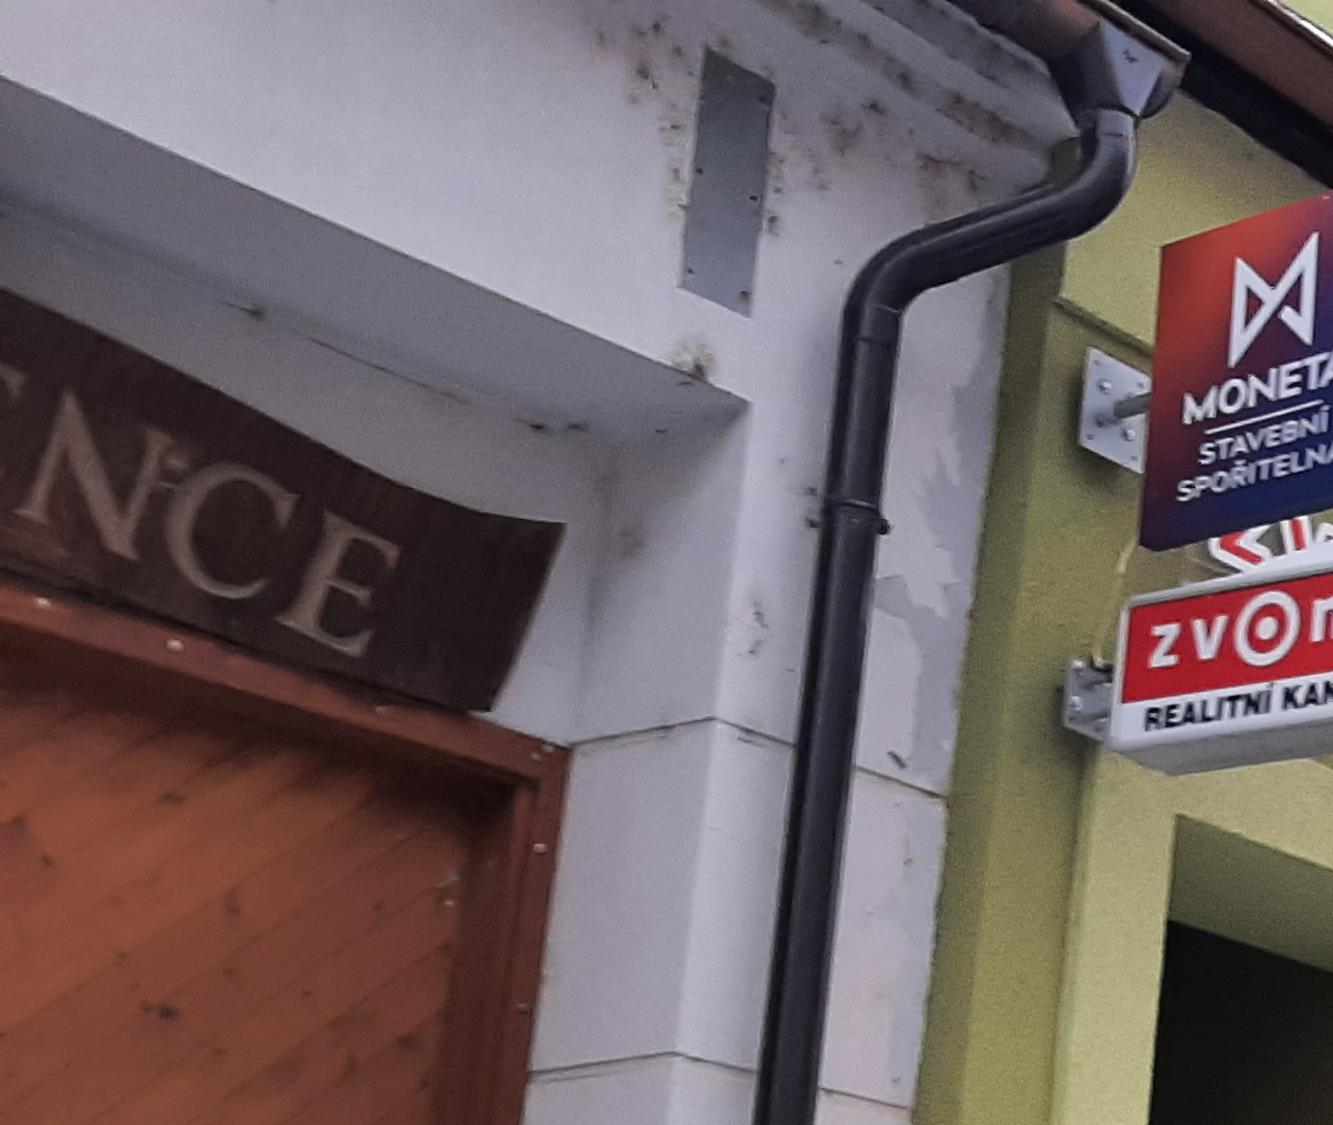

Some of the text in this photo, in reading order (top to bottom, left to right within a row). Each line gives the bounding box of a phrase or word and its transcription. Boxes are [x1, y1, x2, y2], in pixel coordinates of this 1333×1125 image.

[1198, 404, 1331, 465] STAVEBNÍ
[0, 364, 401, 658] NCE
[1144, 681, 1274, 733] REALITNÍ
